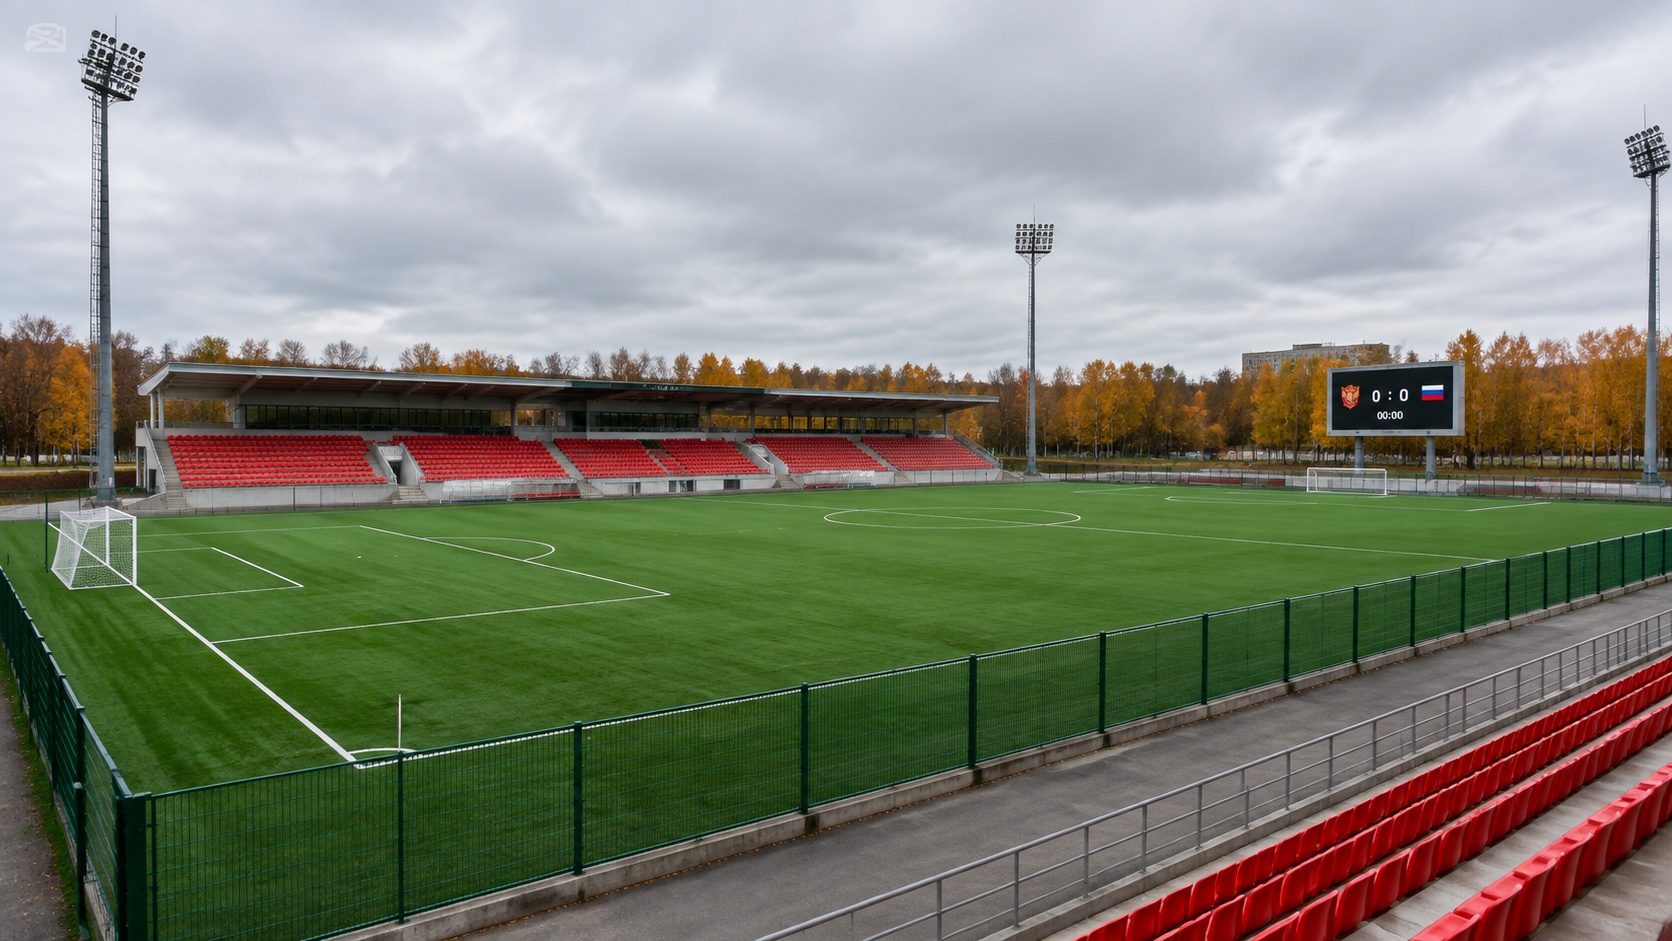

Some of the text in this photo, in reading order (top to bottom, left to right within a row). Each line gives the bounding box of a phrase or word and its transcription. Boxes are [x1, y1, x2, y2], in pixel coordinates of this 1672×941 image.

[1372, 390, 1381, 402] 0
[1399, 388, 1409, 402] 0
[1377, 411, 1403, 420] 00:00
